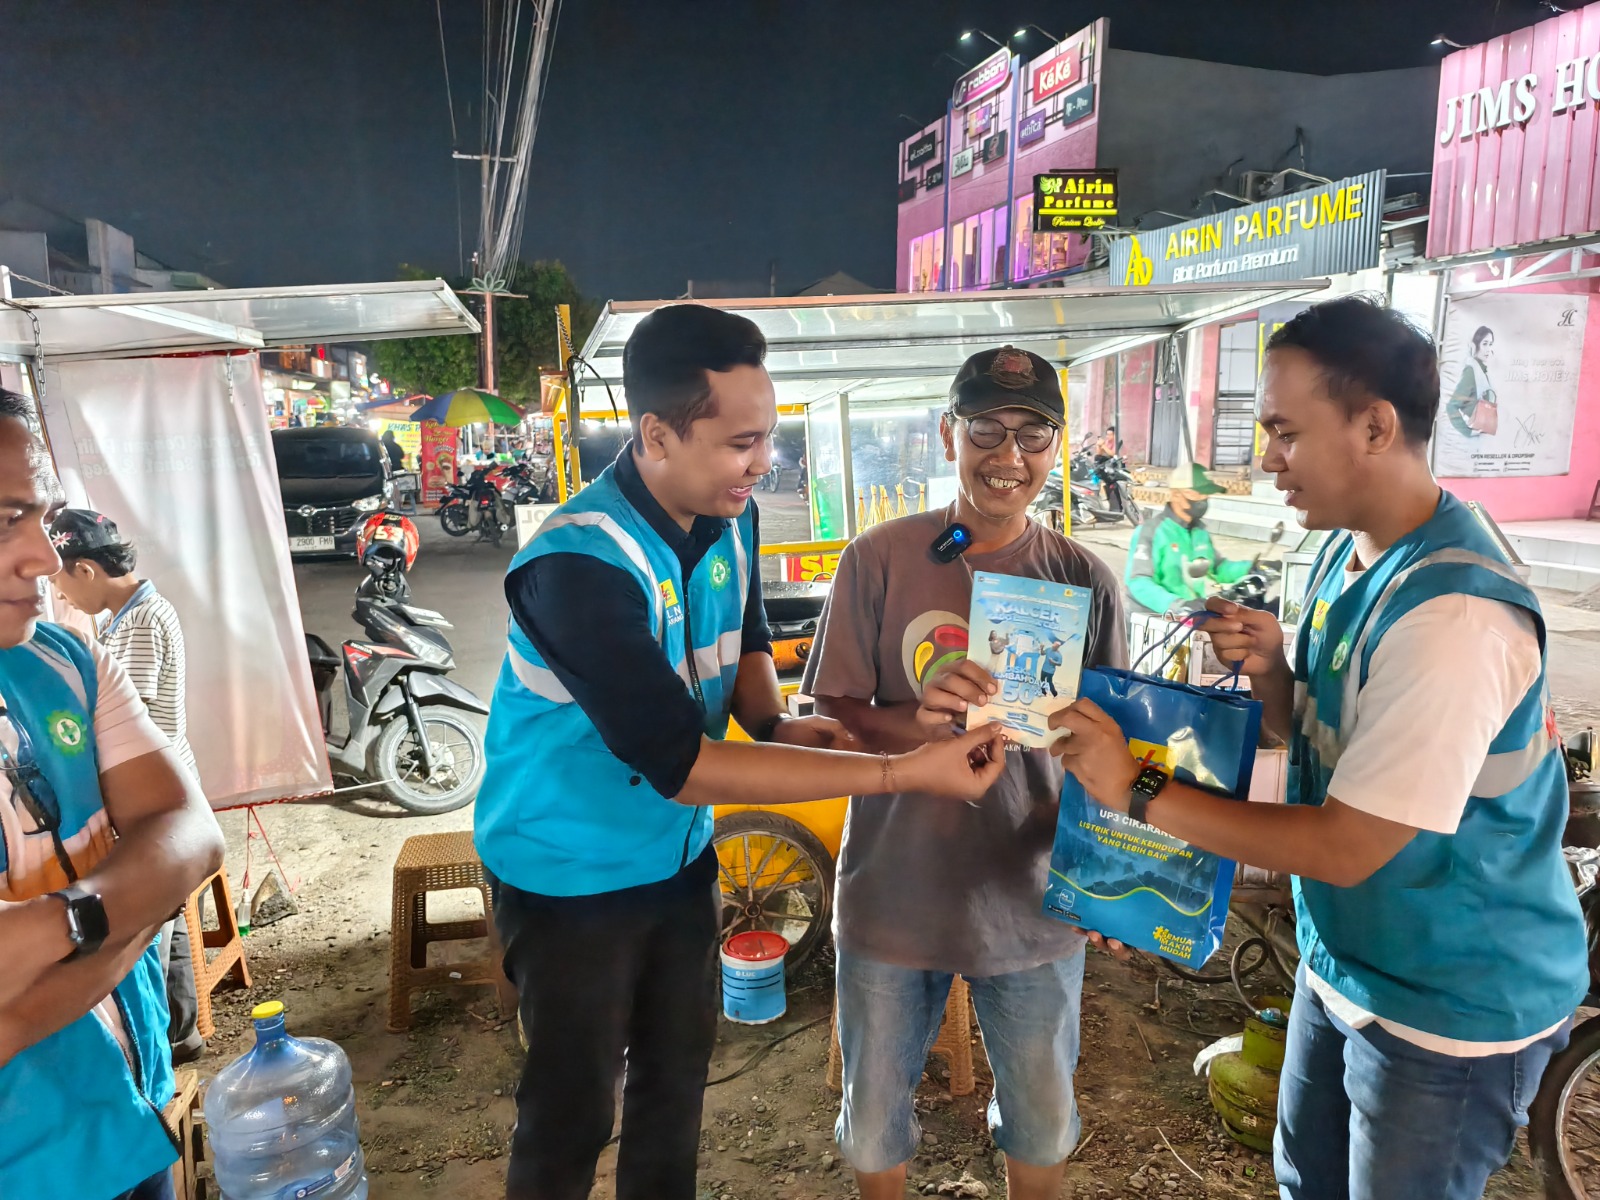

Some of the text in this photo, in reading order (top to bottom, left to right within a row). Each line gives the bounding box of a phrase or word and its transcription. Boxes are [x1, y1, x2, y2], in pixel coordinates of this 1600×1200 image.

[1440, 73, 1537, 144] JIMS
[1063, 178, 1114, 194] Airin
[1165, 183, 1364, 261] AIRIN PARFUME
[1196, 259, 1238, 279] Parfum
[1241, 247, 1298, 271] Premium
[1100, 809, 1120, 822] UP3
[1079, 820, 1193, 859] LISTRIK UNTUK KEHIDUPAN
[1097, 835, 1169, 861] YANG LEBIH BAIK
[1160, 945, 1191, 959] MUDAH
